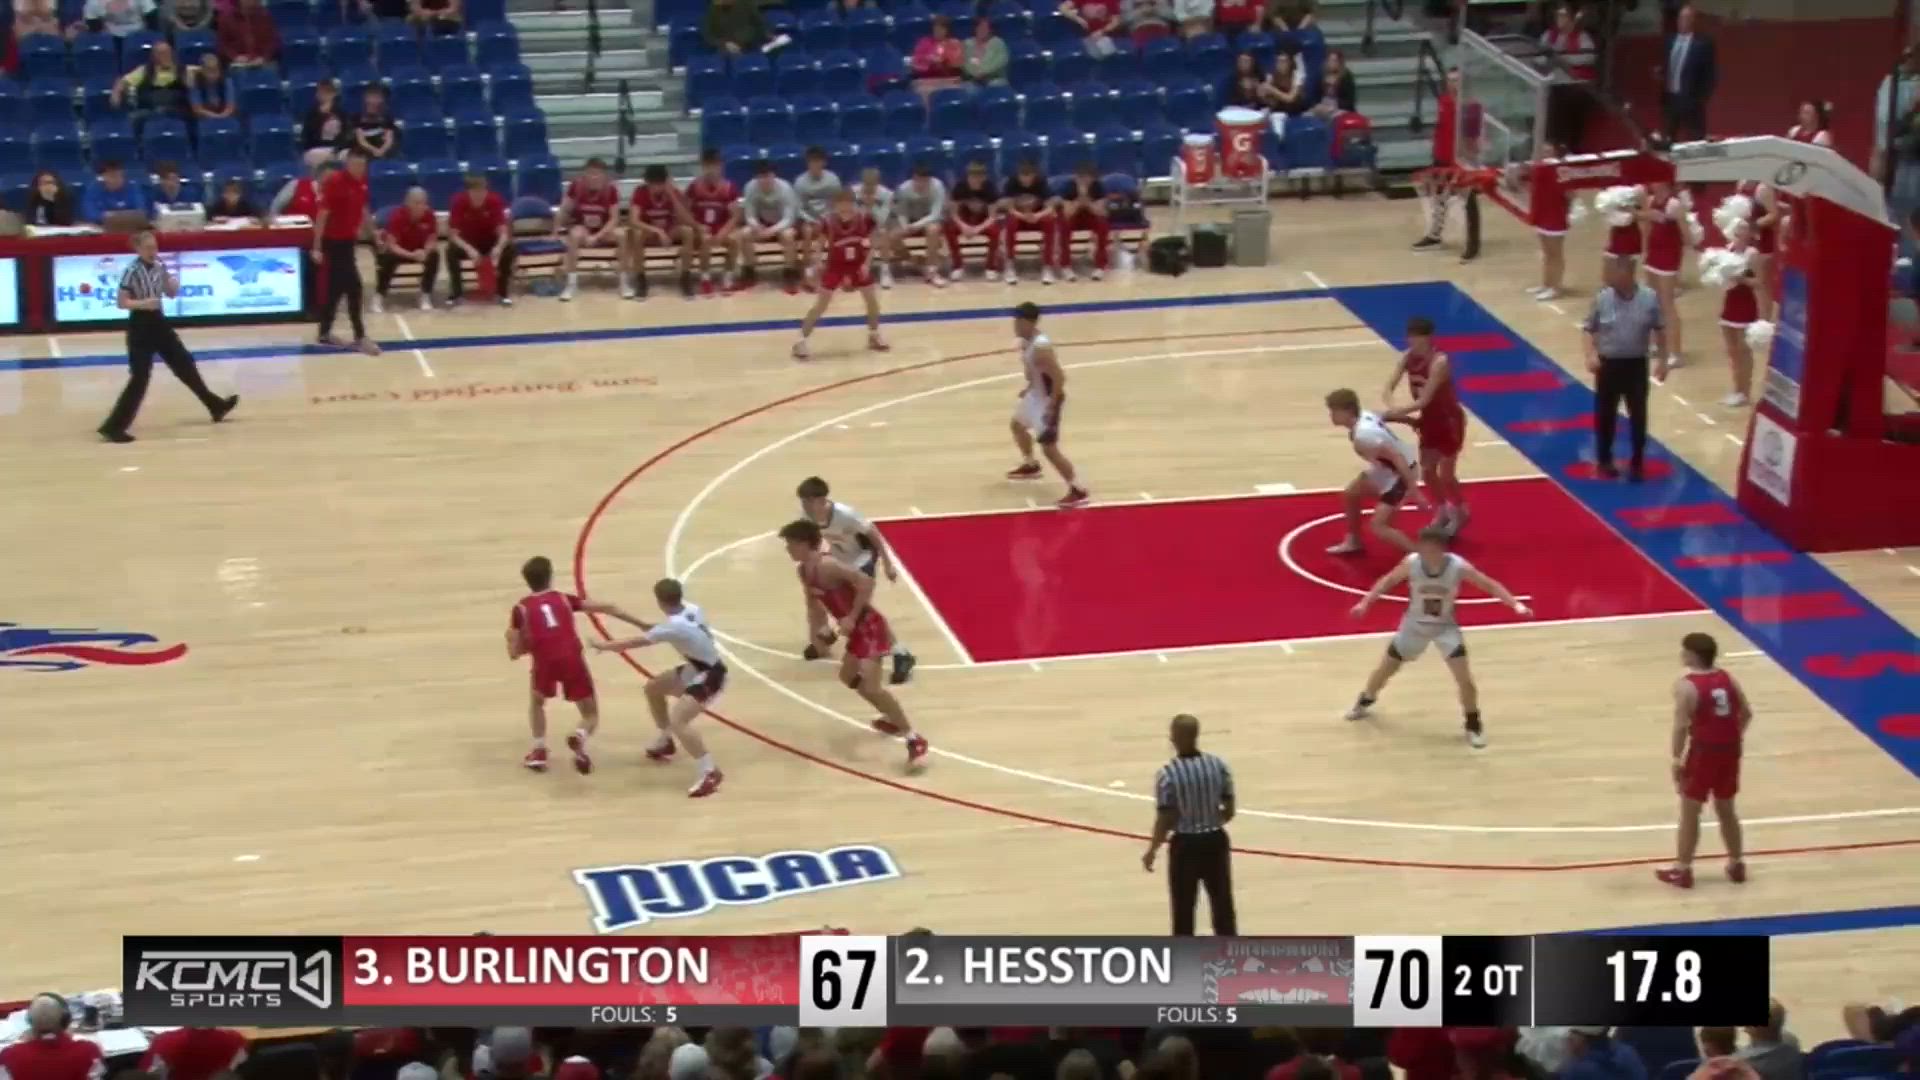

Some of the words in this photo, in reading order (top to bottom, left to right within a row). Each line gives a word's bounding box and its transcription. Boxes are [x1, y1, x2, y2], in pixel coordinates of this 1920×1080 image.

[540, 603, 558, 629] 1
[1711, 688, 1731, 716] 3
[580, 847, 893, 929] NJCAA
